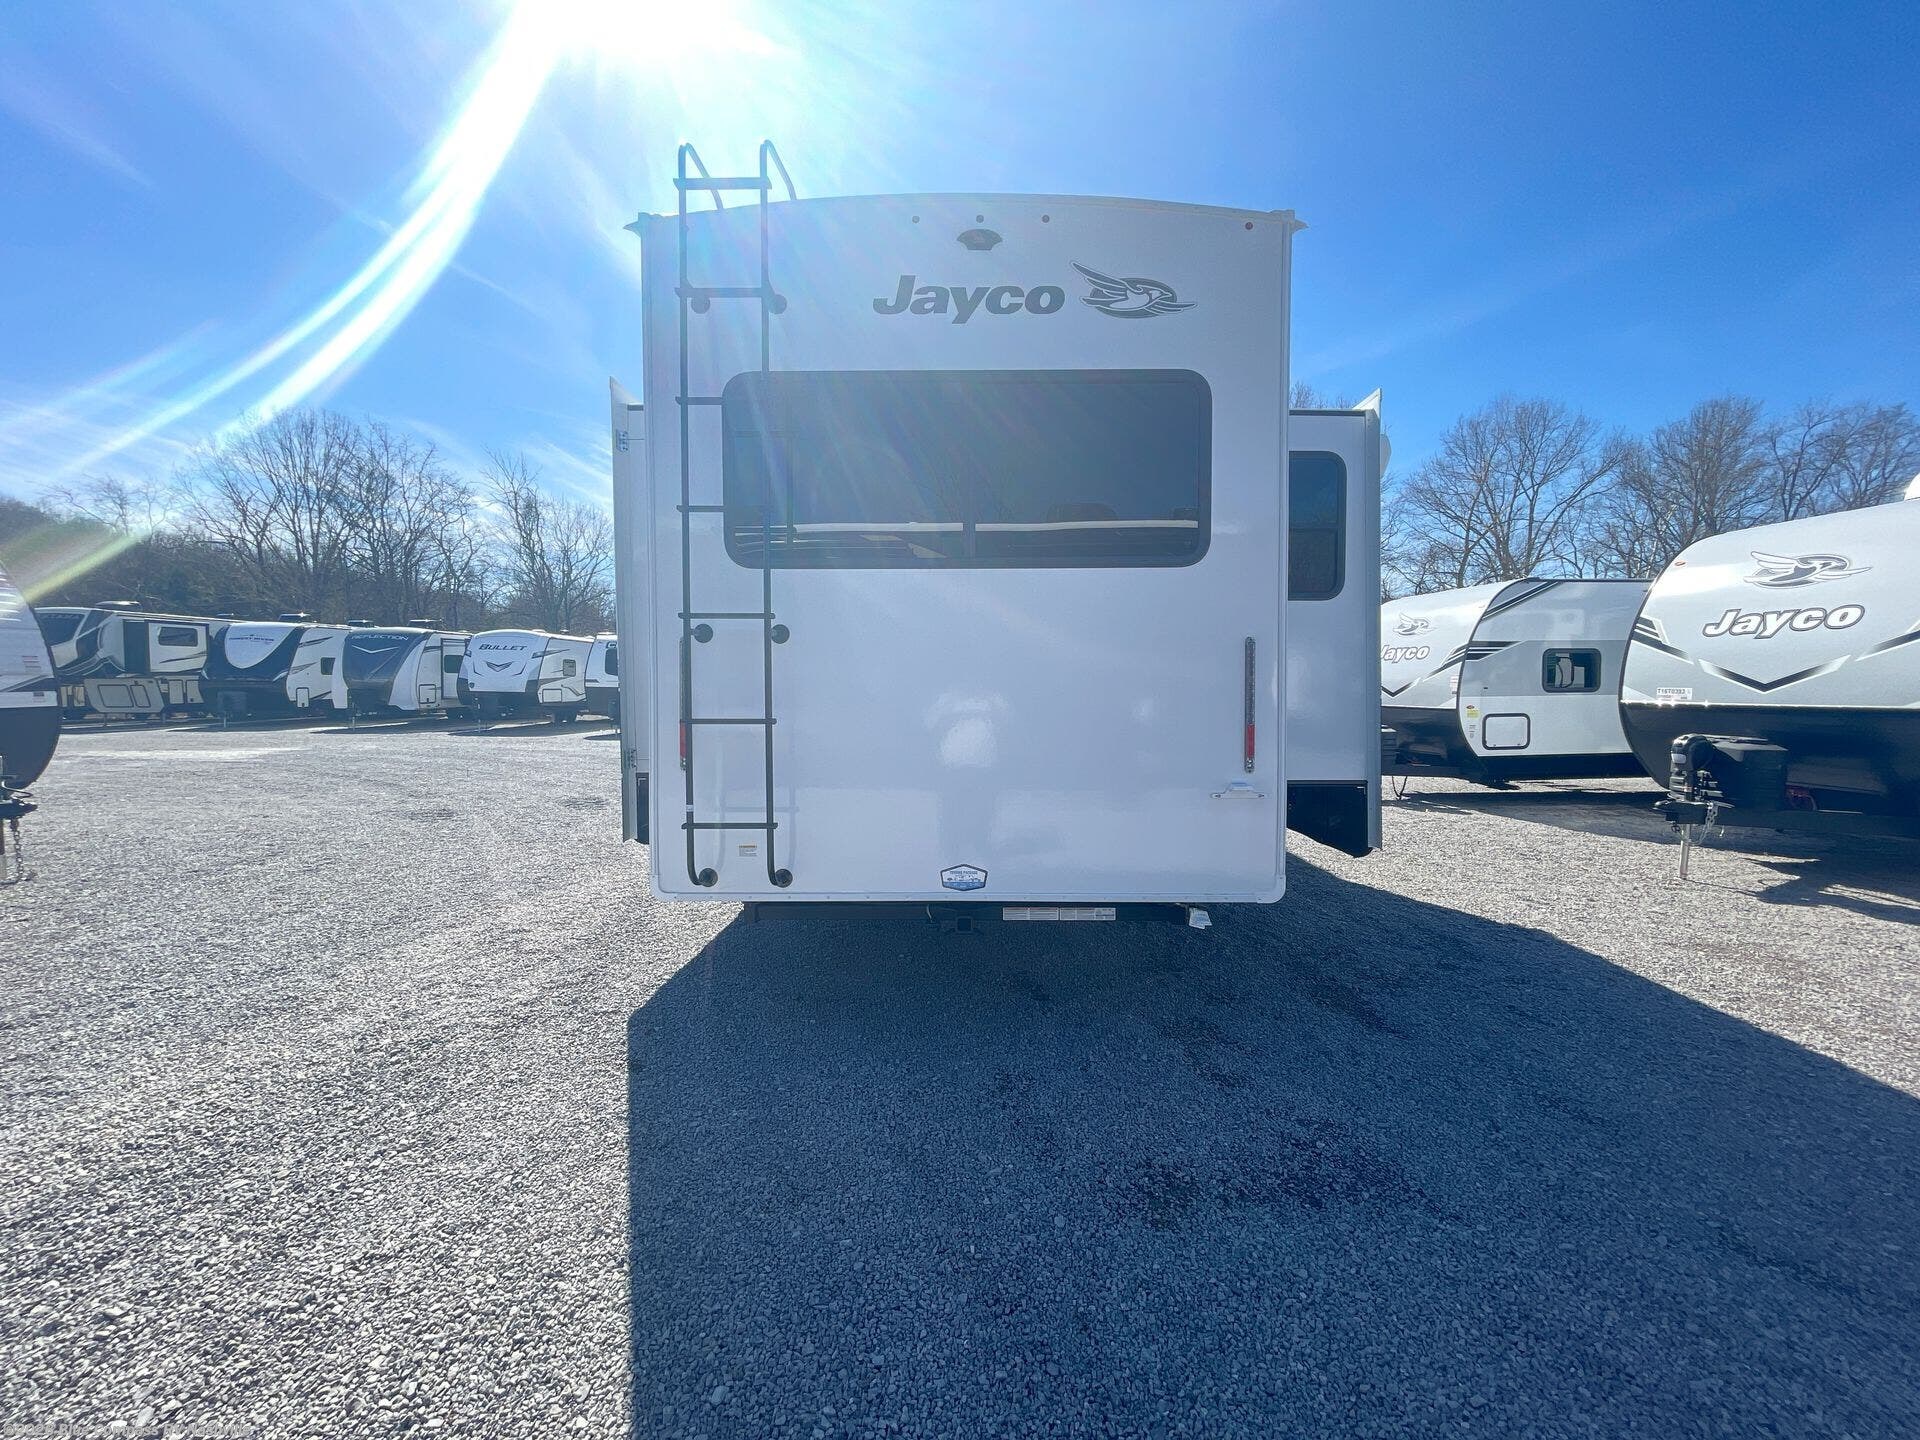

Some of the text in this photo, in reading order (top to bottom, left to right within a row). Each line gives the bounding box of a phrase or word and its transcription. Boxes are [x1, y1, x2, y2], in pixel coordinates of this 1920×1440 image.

[872, 274, 1066, 325] Jayco
[1701, 603, 1867, 640] Jayco
[478, 643, 528, 651] BULLET
